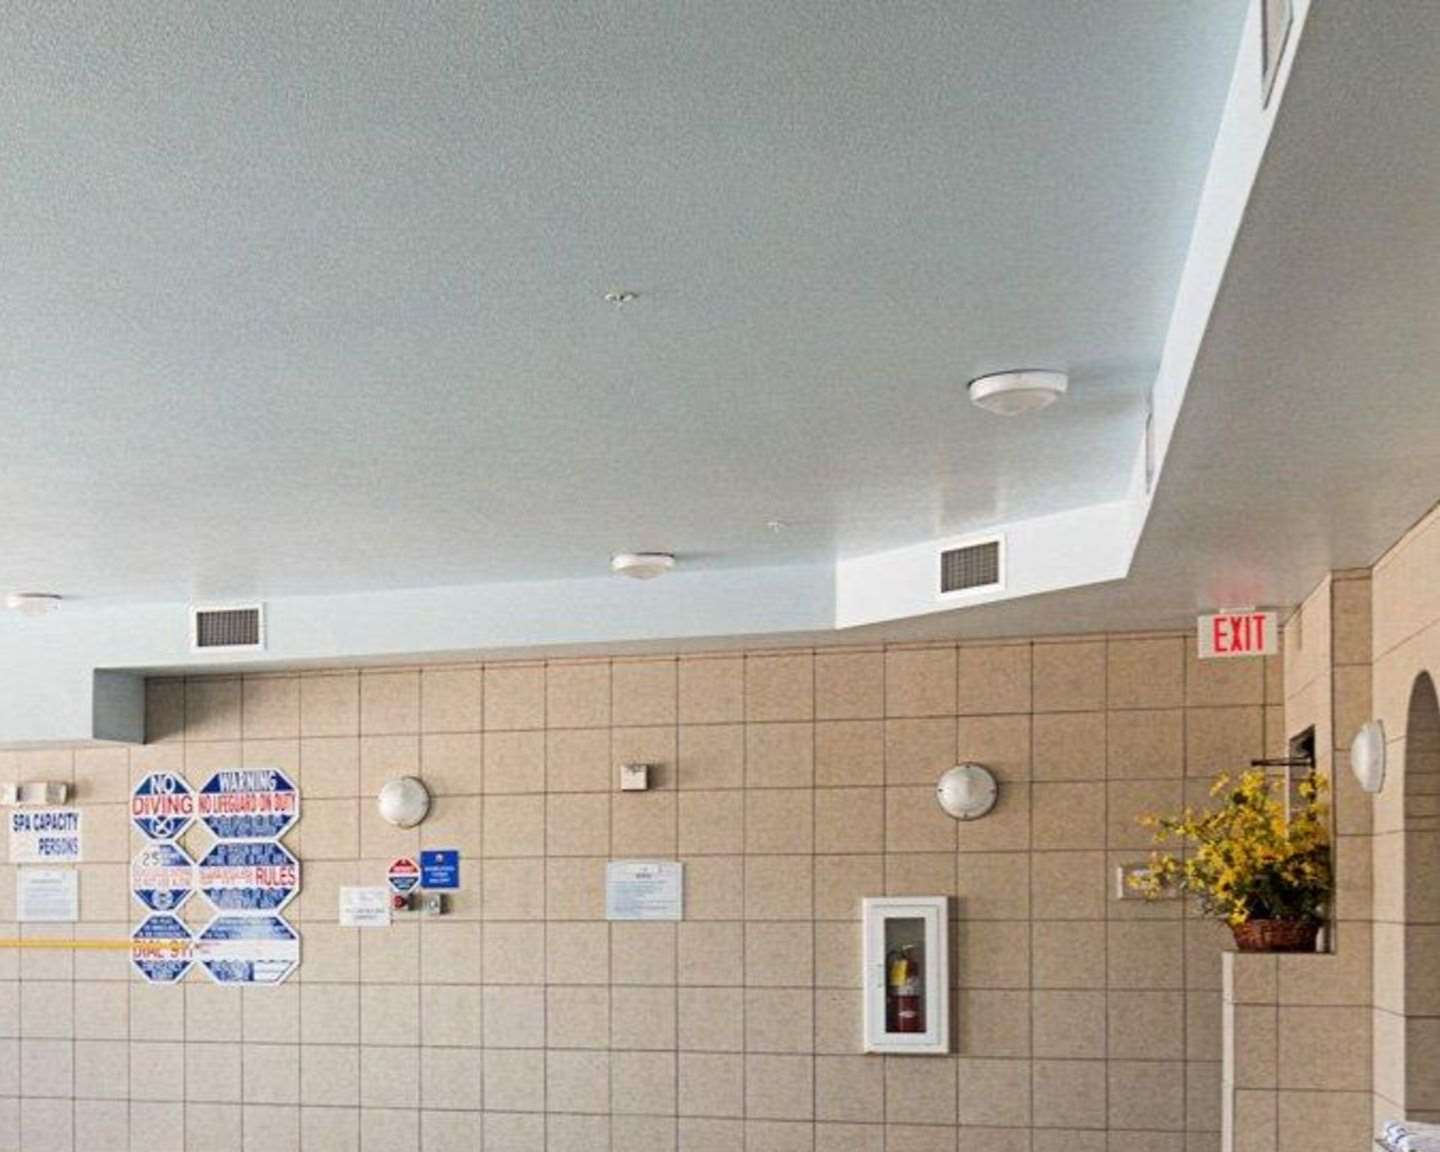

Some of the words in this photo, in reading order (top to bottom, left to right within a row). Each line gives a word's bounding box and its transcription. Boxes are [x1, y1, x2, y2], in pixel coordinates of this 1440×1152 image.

[1212, 615, 1265, 653] EXIT
[149, 774, 176, 794] NO
[219, 770, 278, 792] WARNING
[132, 795, 193, 816] DIVING
[198, 793, 212, 814] NO
[213, 793, 258, 814] LIFEGUARD
[260, 793, 272, 812] ON
[13, 813, 31, 832] SPA
[33, 812, 79, 832] CAPACITY
[39, 837, 78, 855] PERSONS
[256, 867, 296, 886] RULES
